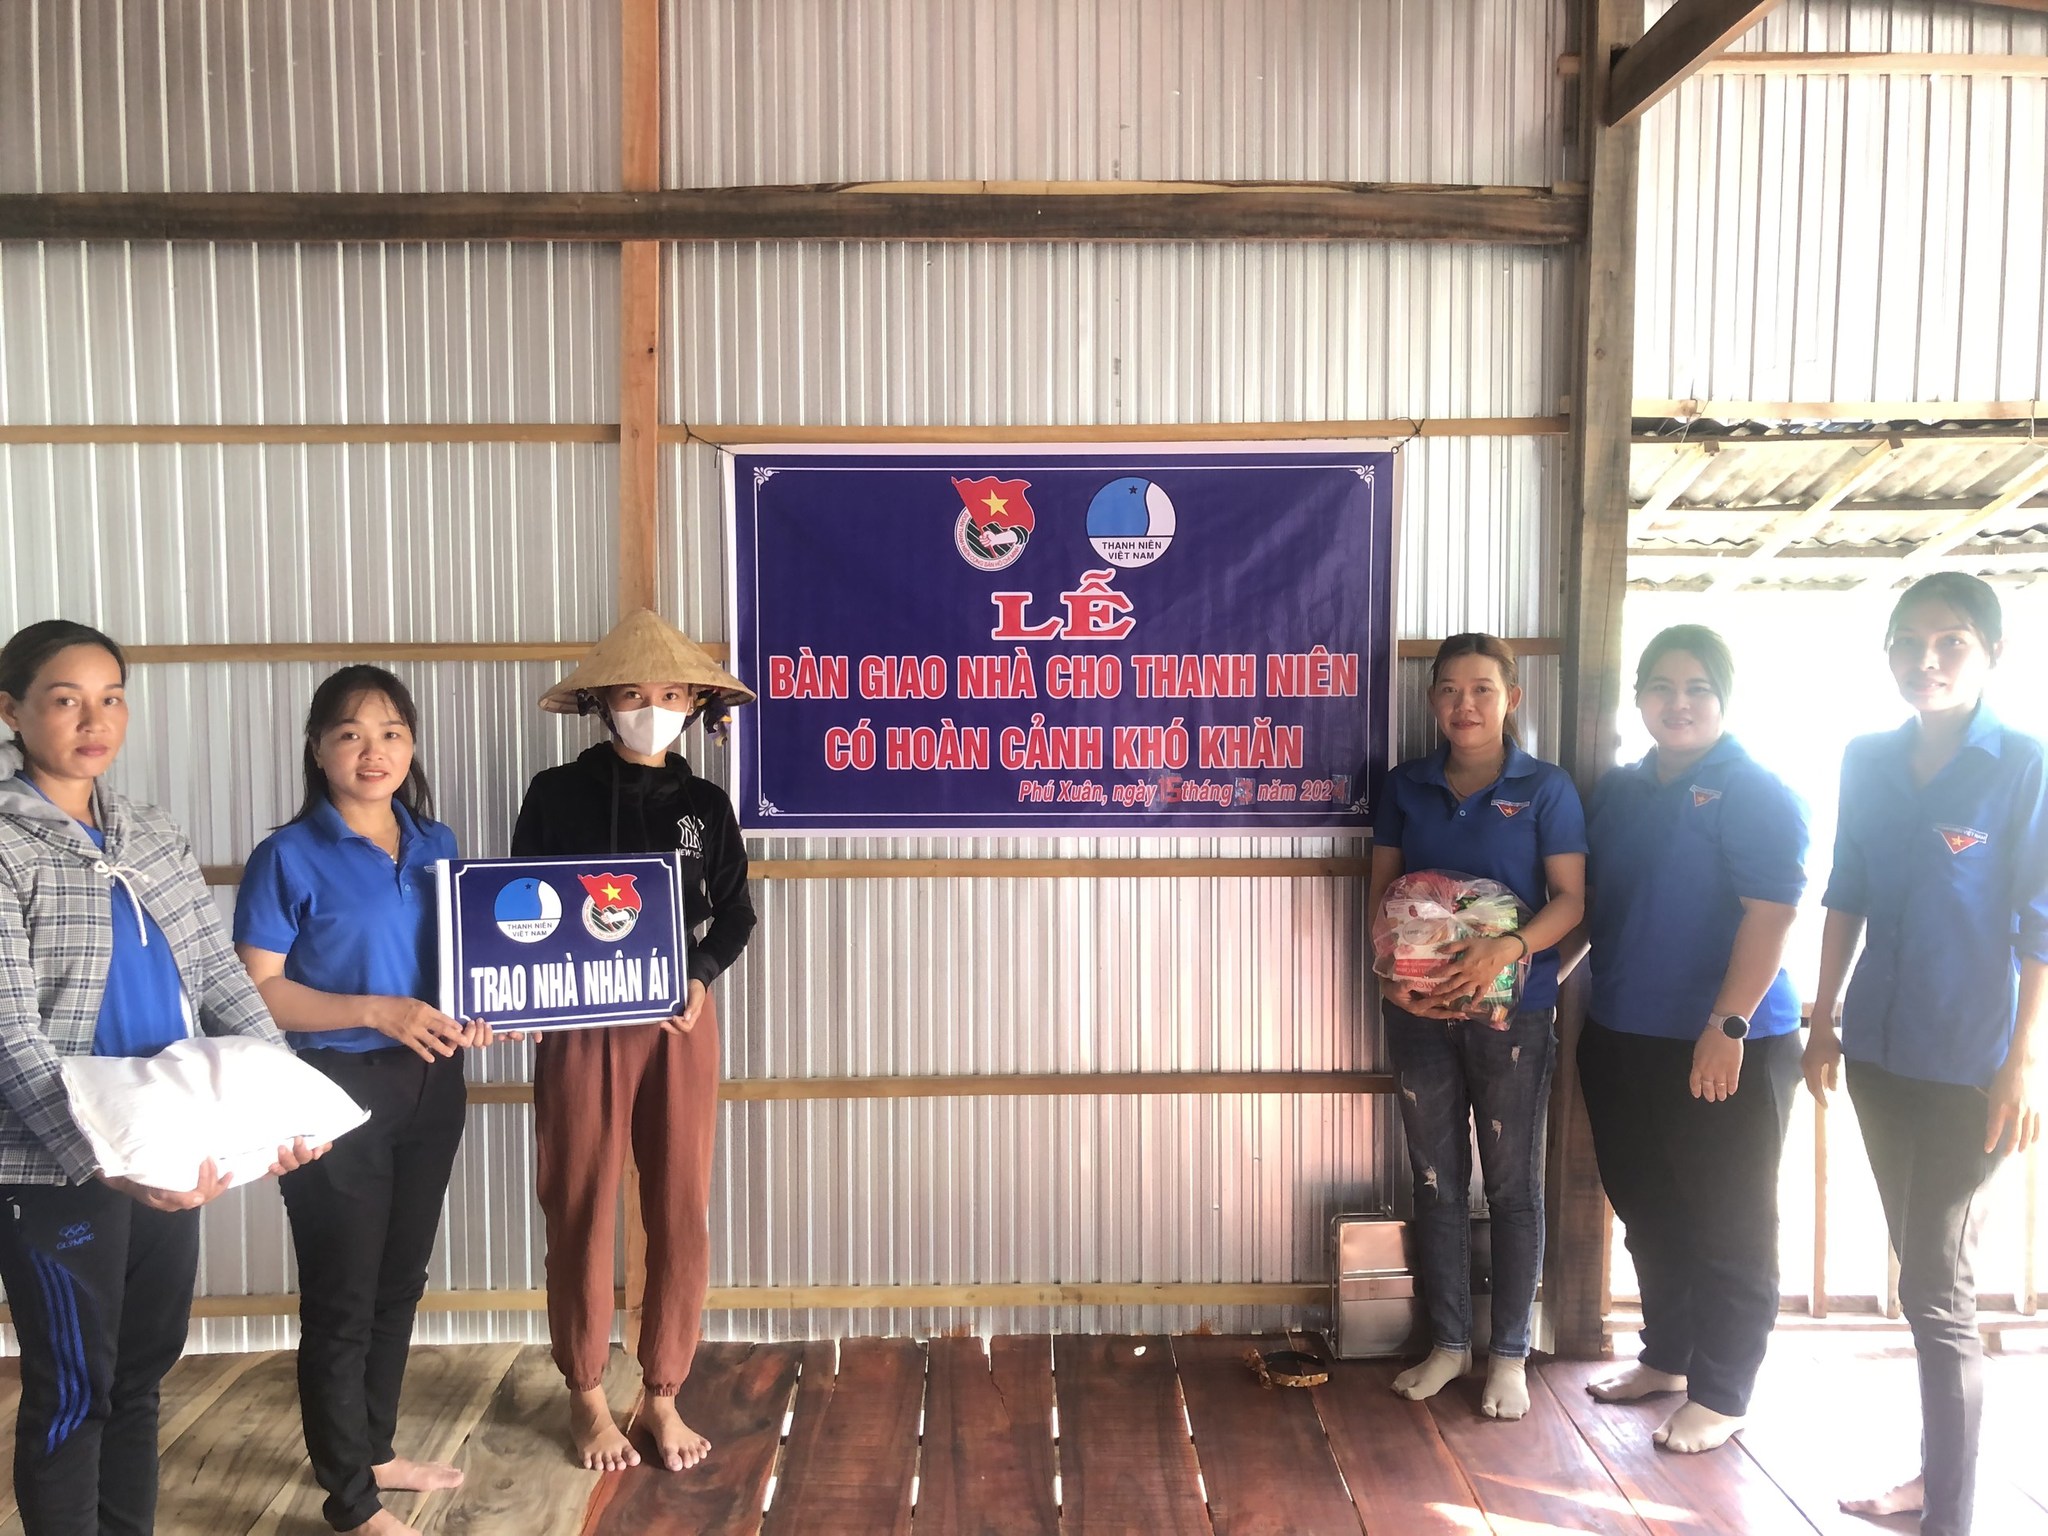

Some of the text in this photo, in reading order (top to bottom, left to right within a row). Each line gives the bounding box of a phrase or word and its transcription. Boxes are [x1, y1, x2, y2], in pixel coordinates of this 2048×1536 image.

[1108, 551, 1130, 561] VIỆT
[1138, 540, 1162, 549] NIÊN
[991, 568, 1136, 640] LỄ
[769, 645, 1358, 699] BÀN GIAO NHÀ CHO THANH NIÊN
[825, 713, 1303, 770] CÓ HOÀN CẢNH KHÓ KHĂN
[1018, 780, 1055, 802] Phú
[1057, 780, 1108, 806] Xuân,
[1112, 779, 1157, 807] ngày
[1181, 780, 1233, 807] tháng
[1257, 779, 1297, 801] năm
[471, 948, 669, 1013] TRAO NHÀ NHÂN ÁI
